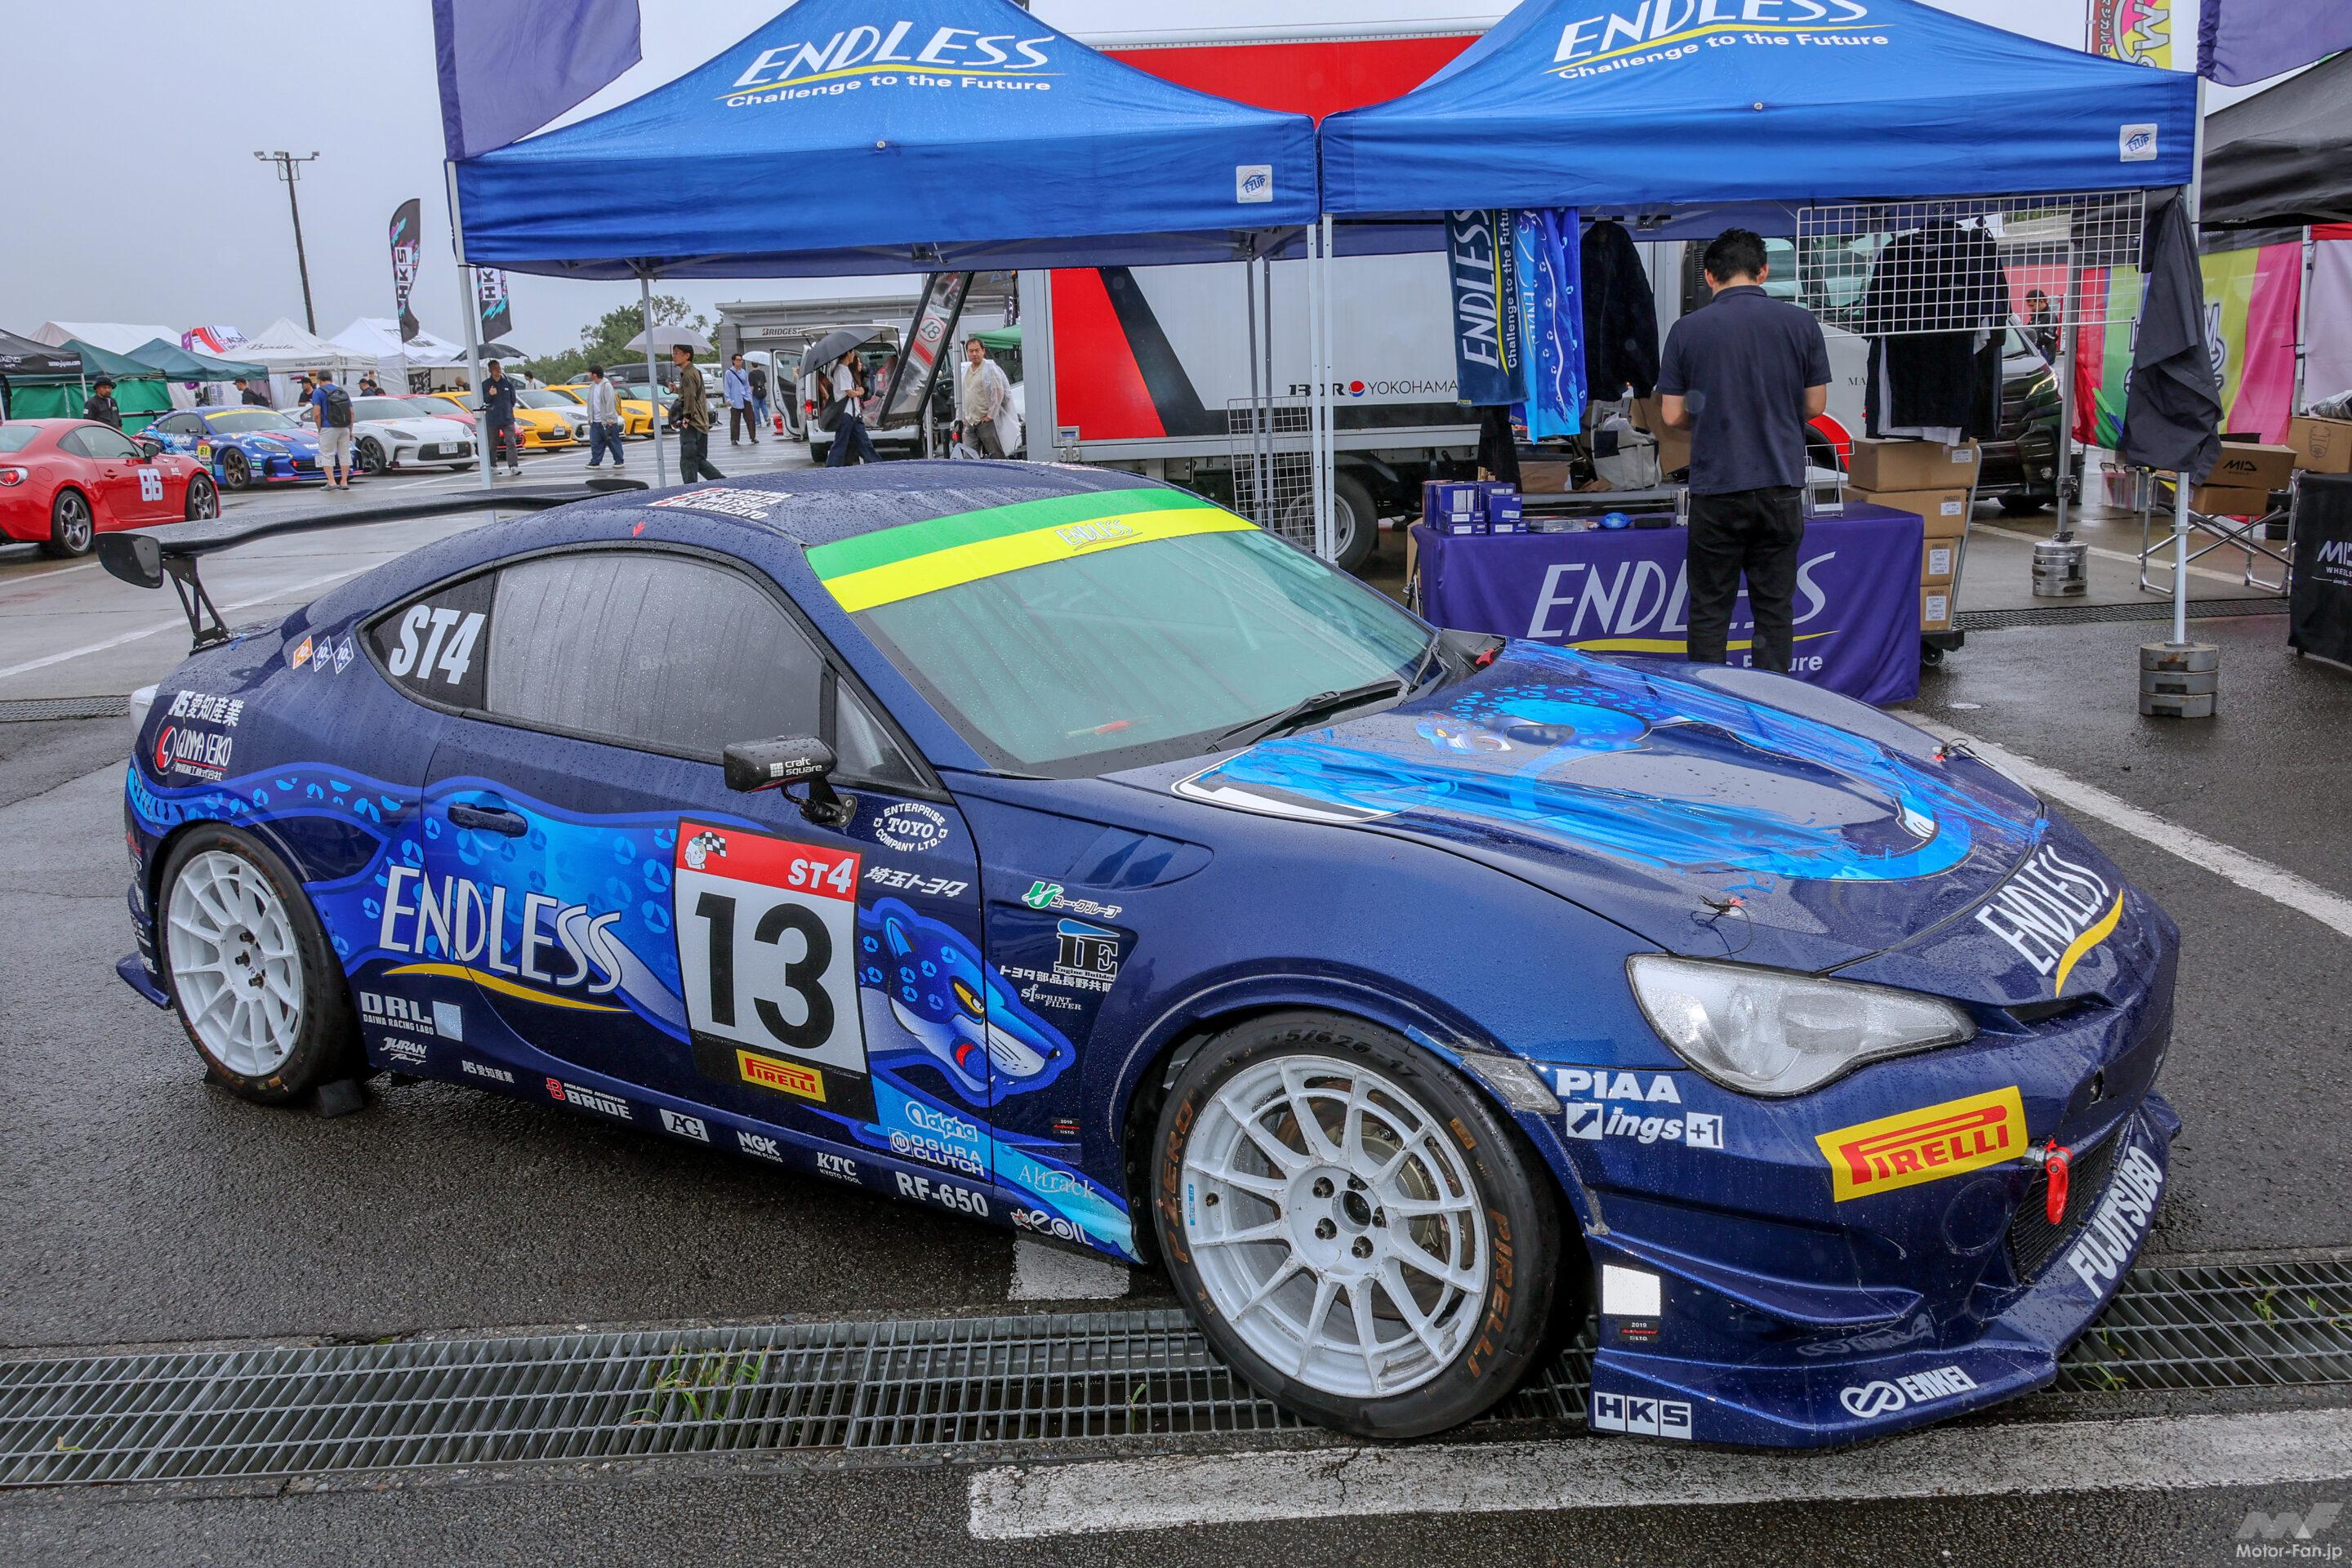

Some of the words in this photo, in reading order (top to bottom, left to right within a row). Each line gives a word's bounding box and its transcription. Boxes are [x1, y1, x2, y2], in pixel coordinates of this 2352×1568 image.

[733, 20, 1055, 87] ENDLESS
[1558, 44, 1699, 79] Challenge
[1706, 33, 1735, 47] to
[1743, 33, 1789, 46] the
[1797, 33, 1889, 46] Future
[726, 80, 862, 108] Challenge
[870, 74, 898, 87] to
[906, 74, 952, 88] the
[961, 77, 1052, 91] Future
[396, 247, 408, 301] HKS
[1500, 250, 1512, 274] the
[1505, 278, 1513, 294] to
[761, 327, 805, 336] BRIDGEST
[1506, 297, 1517, 368] Challenge
[1367, 380, 1459, 395] YOKOHAMA
[199, 446, 209, 455] 61
[137, 469, 163, 501] 86
[1054, 519, 1134, 546] ENDLESS
[1527, 551, 1836, 638] ENDLS
[389, 604, 486, 685] ST4
[203, 733, 233, 767] SEIKO
[786, 764, 823, 776] square
[884, 803, 945, 826] ENTERPRISE
[887, 817, 935, 840] TOYO
[875, 828, 915, 852] COMPANY
[787, 858, 854, 894] ST4
[864, 866, 968, 898] 埼玉トヨタ
[1975, 844, 2110, 977] ENDLESS
[379, 864, 623, 995] ENDLESS
[695, 891, 835, 1049] 13
[359, 991, 433, 1025] DRL
[1035, 994, 1071, 1004] SPRINT
[1045, 1000, 1082, 1011] FILTER
[363, 1013, 387, 1026] DAIWA
[388, 1018, 415, 1031] RACING
[416, 1023, 434, 1036] LABO
[380, 1036, 428, 1055] JURAN
[745, 1058, 817, 1094] PIRELLI
[1555, 1068, 1682, 1103] PIAA
[564, 1082, 593, 1095] HOLDING
[594, 1091, 626, 1104] MONSTER
[564, 1089, 633, 1120] BRIDE
[670, 1112, 703, 1138] AG
[737, 1130, 780, 1157] NGK
[742, 1147, 763, 1158] SPARK
[763, 1152, 783, 1163] PLUGS
[911, 1134, 982, 1164] OGURA
[1838, 1104, 2011, 1186] PIRELLI
[817, 1152, 858, 1176] KTC
[819, 1168, 842, 1179] KYOTO
[843, 1174, 862, 1185] TOOL
[913, 1147, 985, 1177] CLUTCH
[895, 1170, 989, 1218] RF-650
[1018, 1164, 1095, 1200] Altrack
[2067, 1145, 2164, 1298] FUJITSUBO
[1895, 1365, 1978, 1403] ENKEI
[1597, 1393, 1690, 1432] HKS
